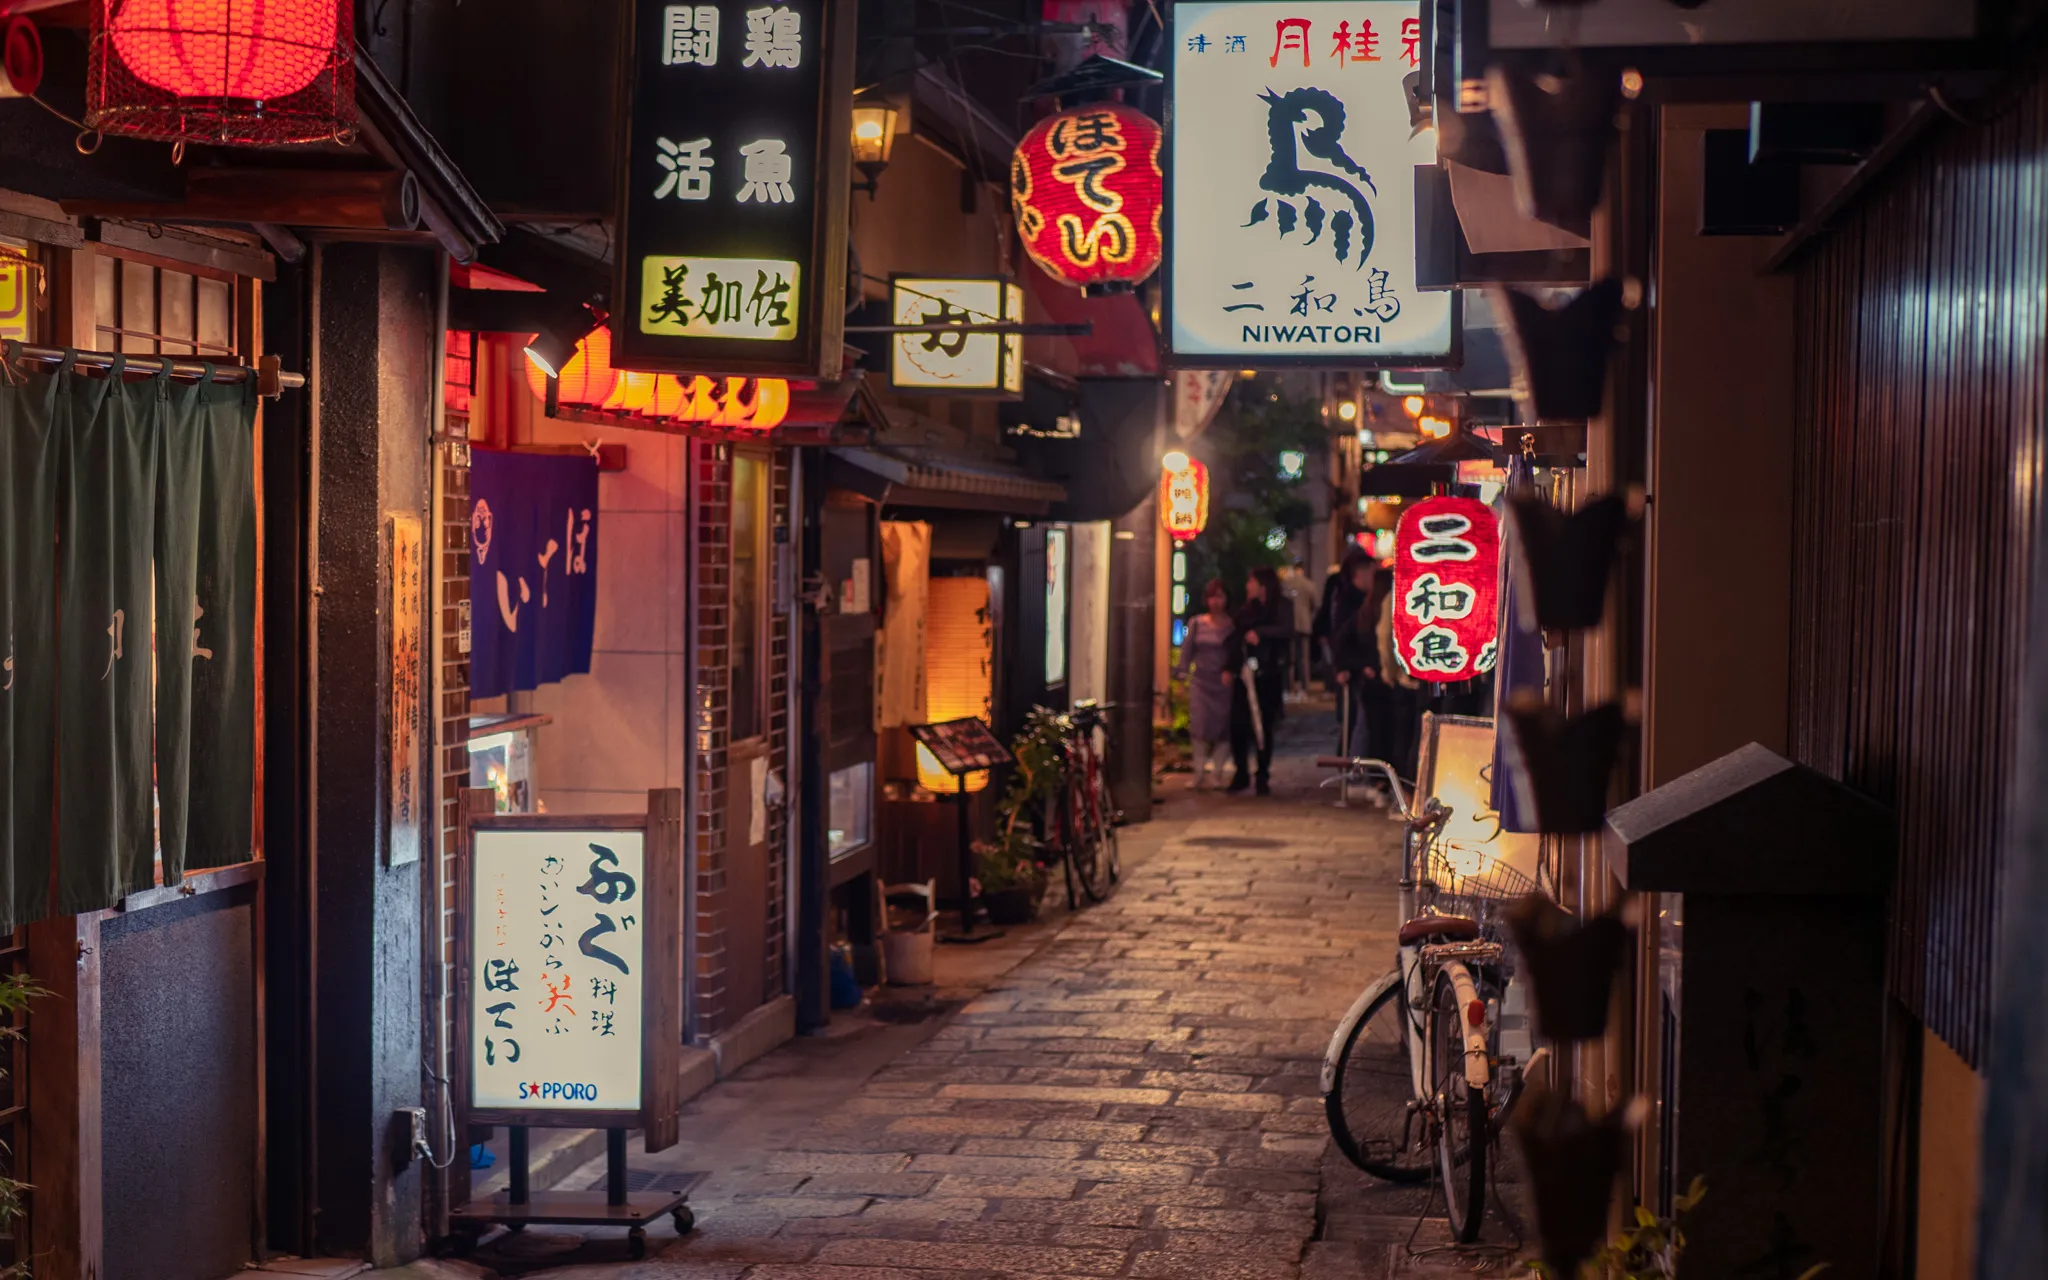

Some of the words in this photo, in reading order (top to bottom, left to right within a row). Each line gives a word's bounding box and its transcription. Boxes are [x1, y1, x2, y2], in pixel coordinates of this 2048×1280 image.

[662, 5, 801, 68] 闘鶏
[1187, 33, 1247, 54] 清酒
[653, 136, 795, 204] 活魚
[1049, 112, 1131, 264] ほてい
[648, 263, 790, 327] 美加佐
[1222, 267, 1402, 324] 二和鳥
[1243, 325, 1381, 343] NIWATORI
[1410, 516, 1473, 671] 二和鳥
[484, 958, 520, 1065] ほてい
